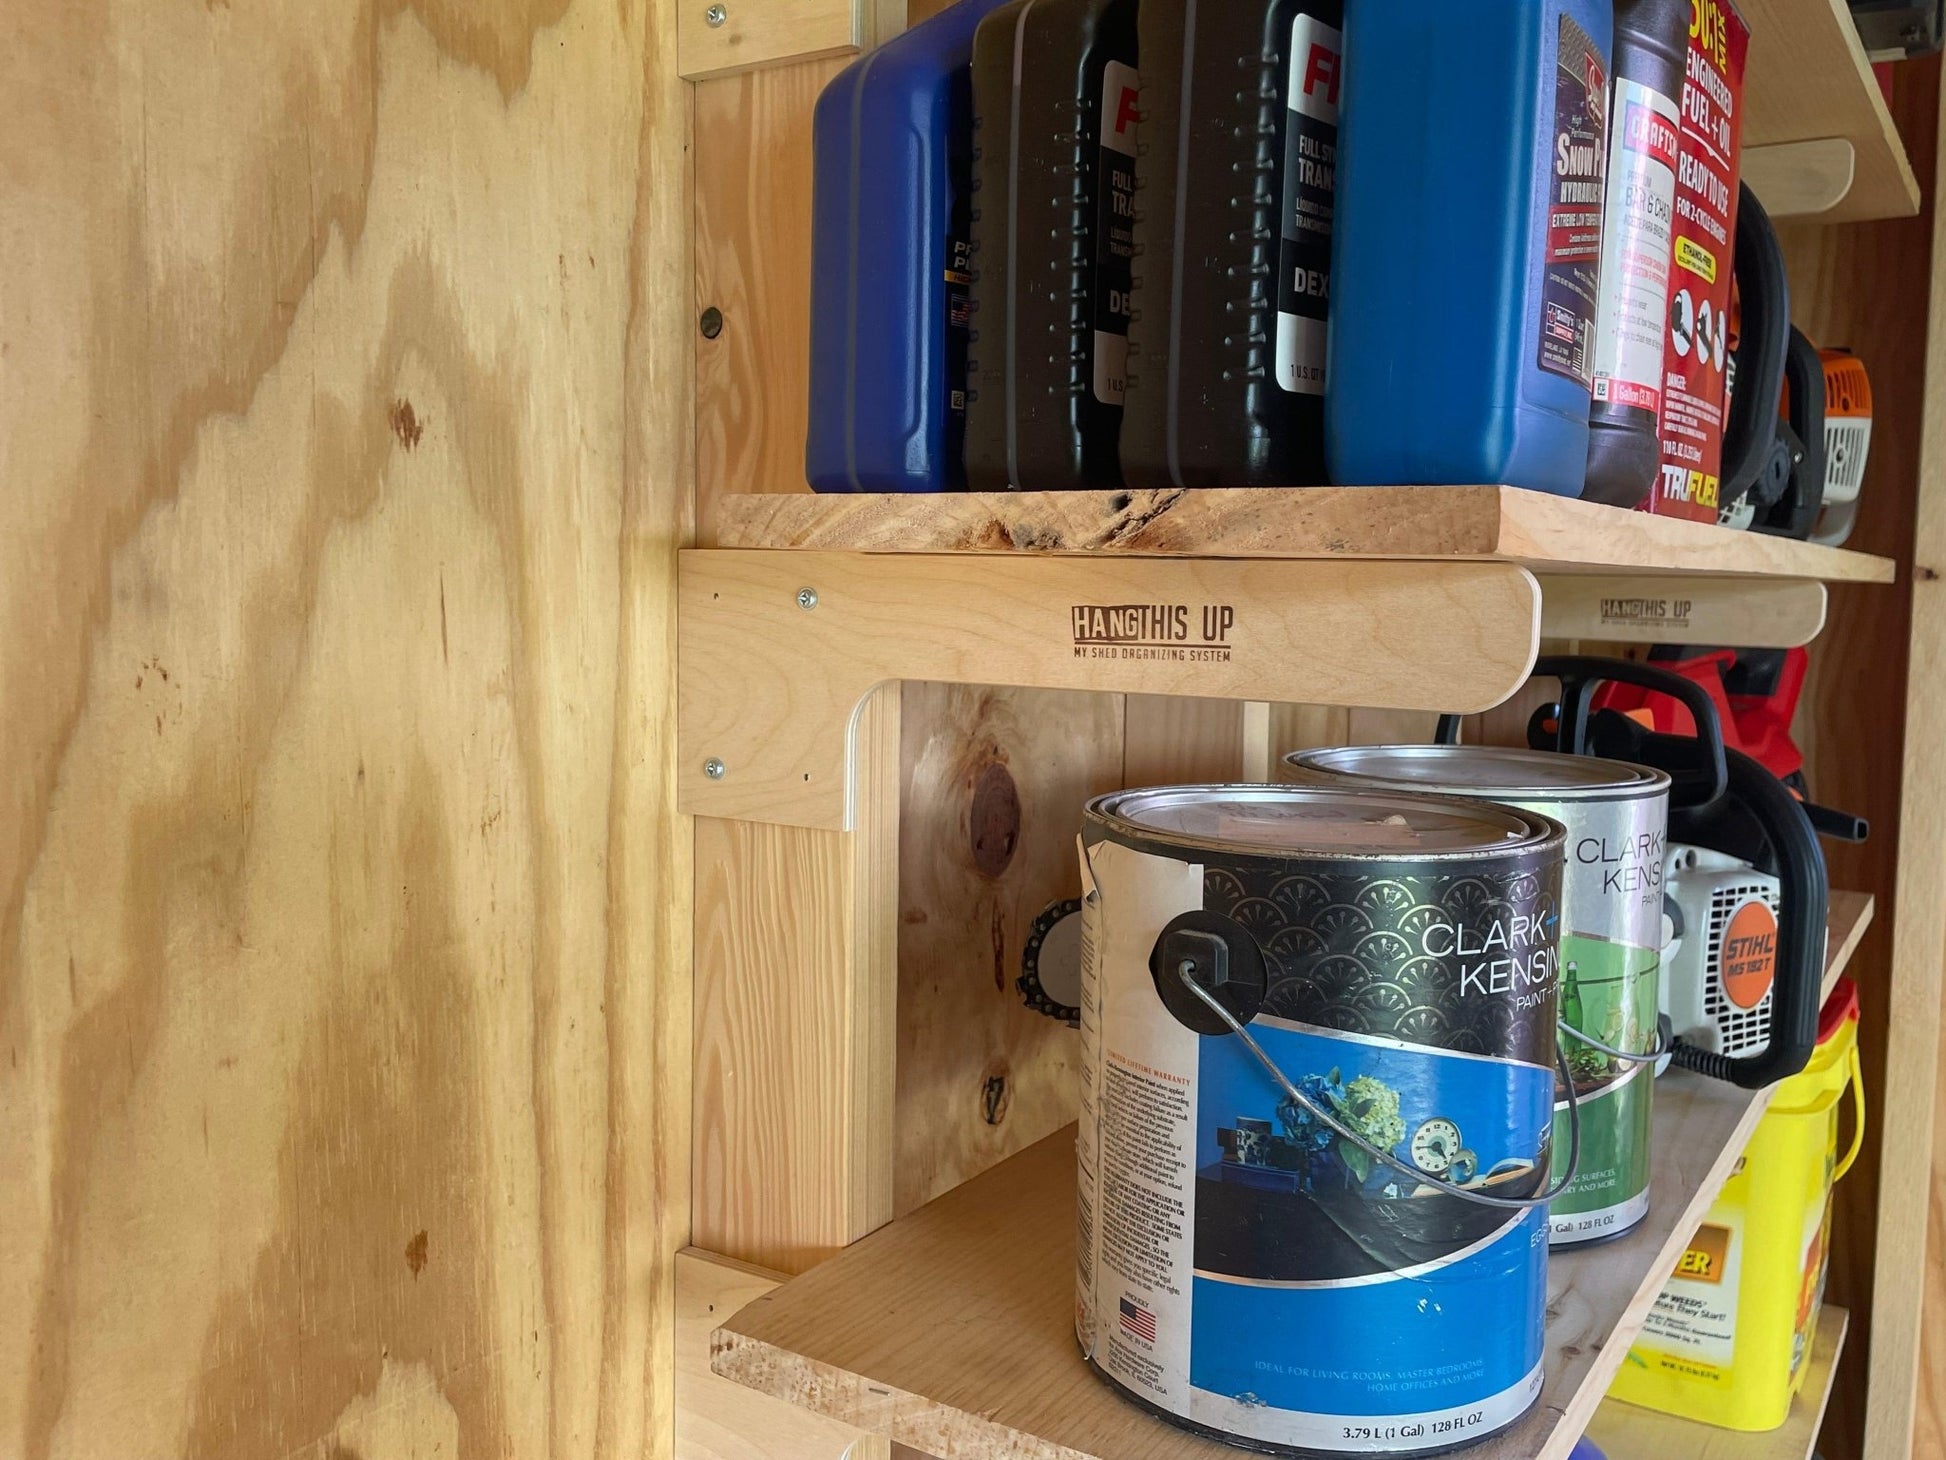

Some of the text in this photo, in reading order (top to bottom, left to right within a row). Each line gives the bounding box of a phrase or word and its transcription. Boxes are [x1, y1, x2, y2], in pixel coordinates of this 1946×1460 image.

[1686, 46, 1733, 119] ENGINEERED
[1682, 82, 1710, 134] FUEL
[1719, 116, 1731, 157] OIL
[1299, 134, 1320, 160] FULL
[1678, 150, 1729, 218] READY TO USE
[1676, 196, 1690, 220] FOR
[1294, 266, 1329, 299] DEX
[1619, 384, 1639, 404] Gallon
[1661, 463, 1720, 509] TRUFUEL
[1674, 600, 1691, 618] UP
[1203, 605, 1234, 641] UP
[1074, 646, 1231, 662] MY SHED ORGANIZING SYSTEM
[1726, 933, 1774, 960] STIHL
[1727, 962, 1745, 977] MS
[1764, 957, 1772, 971] T
[1154, 1068, 1190, 1087] WARRANTY
[1581, 1168, 1616, 1182] SURFACES
[1579, 1182, 1596, 1193] AND
[1597, 1178, 1616, 1190] MORE
[1145, 1196, 1184, 1216] APPLICATION OR
[1151, 1191, 1171, 1204] INCLUDE
[1173, 1199, 1182, 1207] THE
[1165, 1219, 1180, 1230] FROM
[1165, 1227, 1182, 1239] STATES
[1555, 1222, 1573, 1232] Gal)
[1578, 1219, 1592, 1230] 128
[1594, 1218, 1602, 1228] FL
[1603, 1214, 1614, 1225] OZ
[1142, 1340, 1153, 1352] USA
[1254, 1360, 1284, 1375] IDEAL
[1288, 1366, 1310, 1378] FOR
[1311, 1368, 1349, 1381] LIVING
[1397, 1367, 1434, 1380] MASTER
[1435, 1358, 1484, 1376] BEDROOMS
[1155, 1384, 1167, 1395] USA
[1367, 1369, 1485, 1392] HOME OFFICES AND MORE
[1342, 1411, 1483, 1440] 3.79 L (1 Gal) 128 FL OZ
